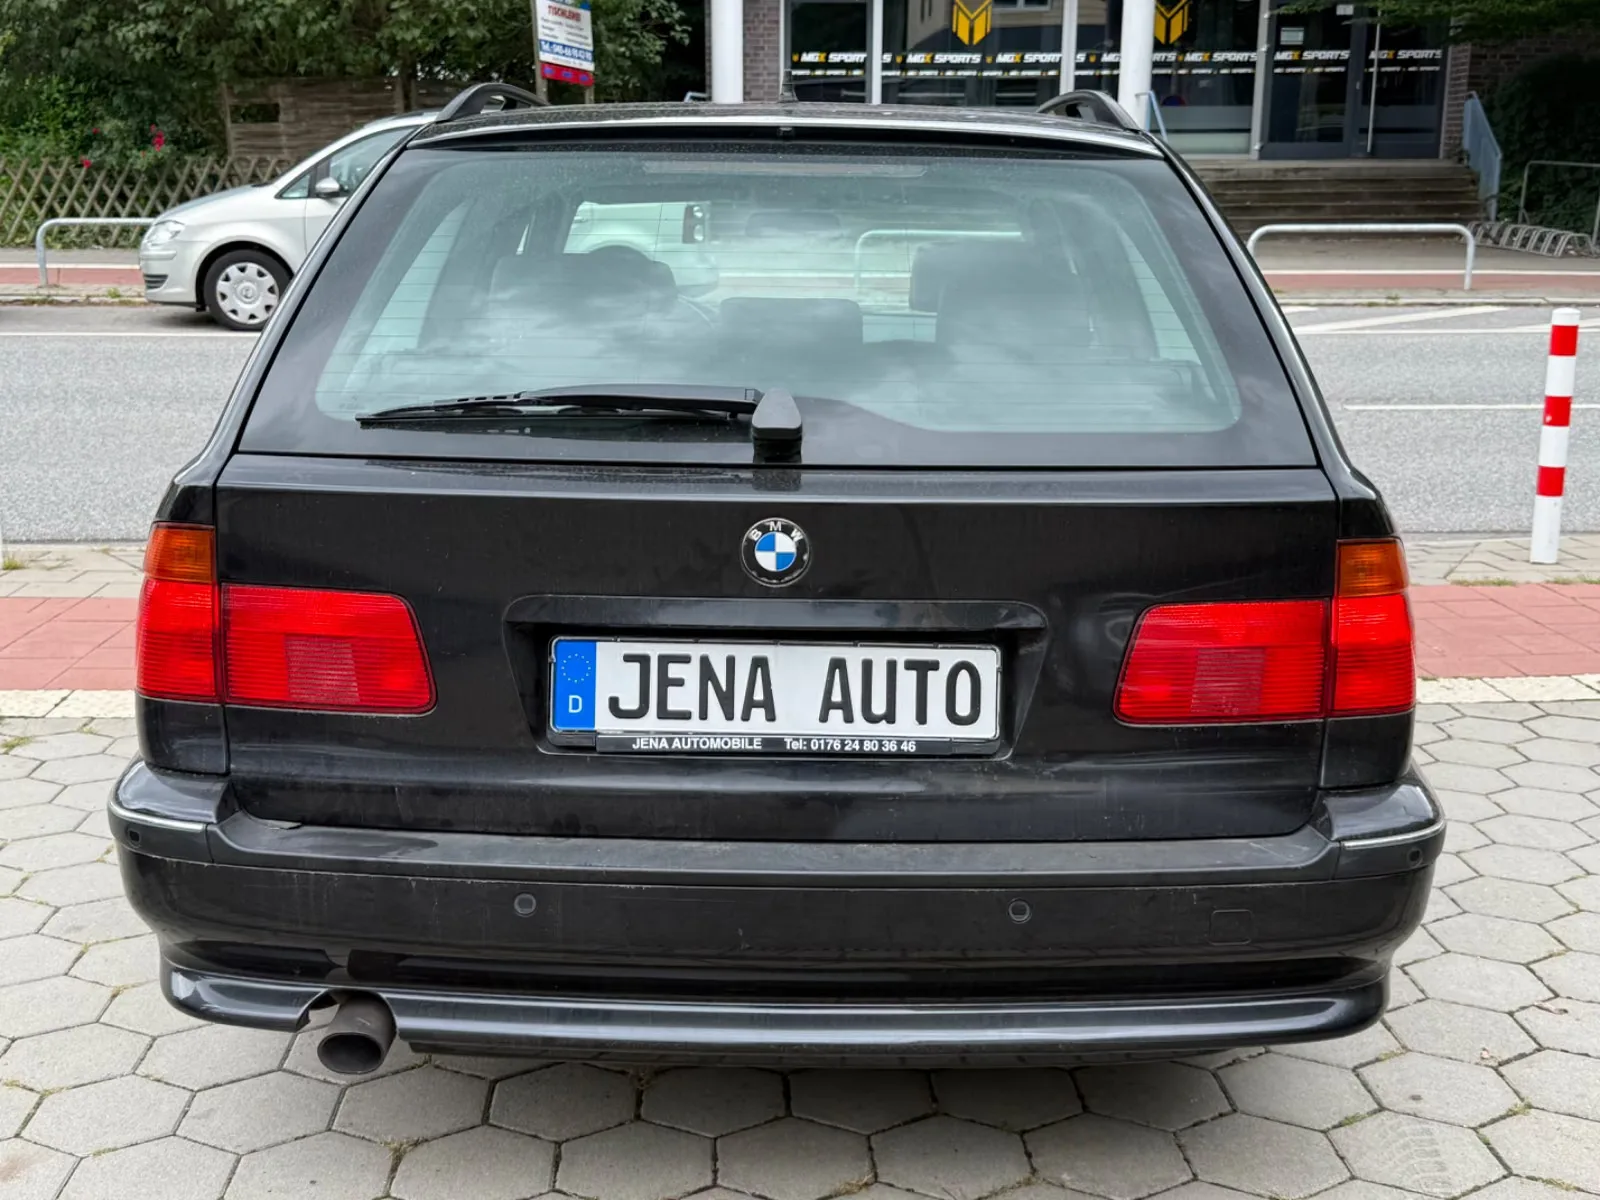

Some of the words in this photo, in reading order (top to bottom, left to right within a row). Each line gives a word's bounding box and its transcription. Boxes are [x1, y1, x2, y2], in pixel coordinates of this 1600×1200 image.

[800, 52, 827, 63] MGX
[906, 52, 934, 64] MGX
[933, 52, 982, 64] SPORTS
[995, 52, 1023, 63] MGX
[1101, 52, 1121, 63] MG
[1184, 51, 1211, 62] MGX
[1211, 51, 1257, 62] SPORTS
[1274, 50, 1301, 61] MGX
[1301, 49, 1350, 60] SPORTS
[1396, 49, 1443, 59] SPORTS
[748, 520, 804, 542] BMW
[608, 653, 776, 722] JENA
[818, 656, 981, 726] AUTO
[568, 695, 583, 713] D
[632, 738, 669, 750] JENA
[672, 738, 762, 750] AUTOMOBILE
[784, 738, 807, 750] Tel:
[810, 739, 841, 751] 0176
[844, 740, 860, 751] 24
[863, 740, 878, 751] 80
[881, 741, 897, 752] 36
[900, 741, 916, 752] 46
